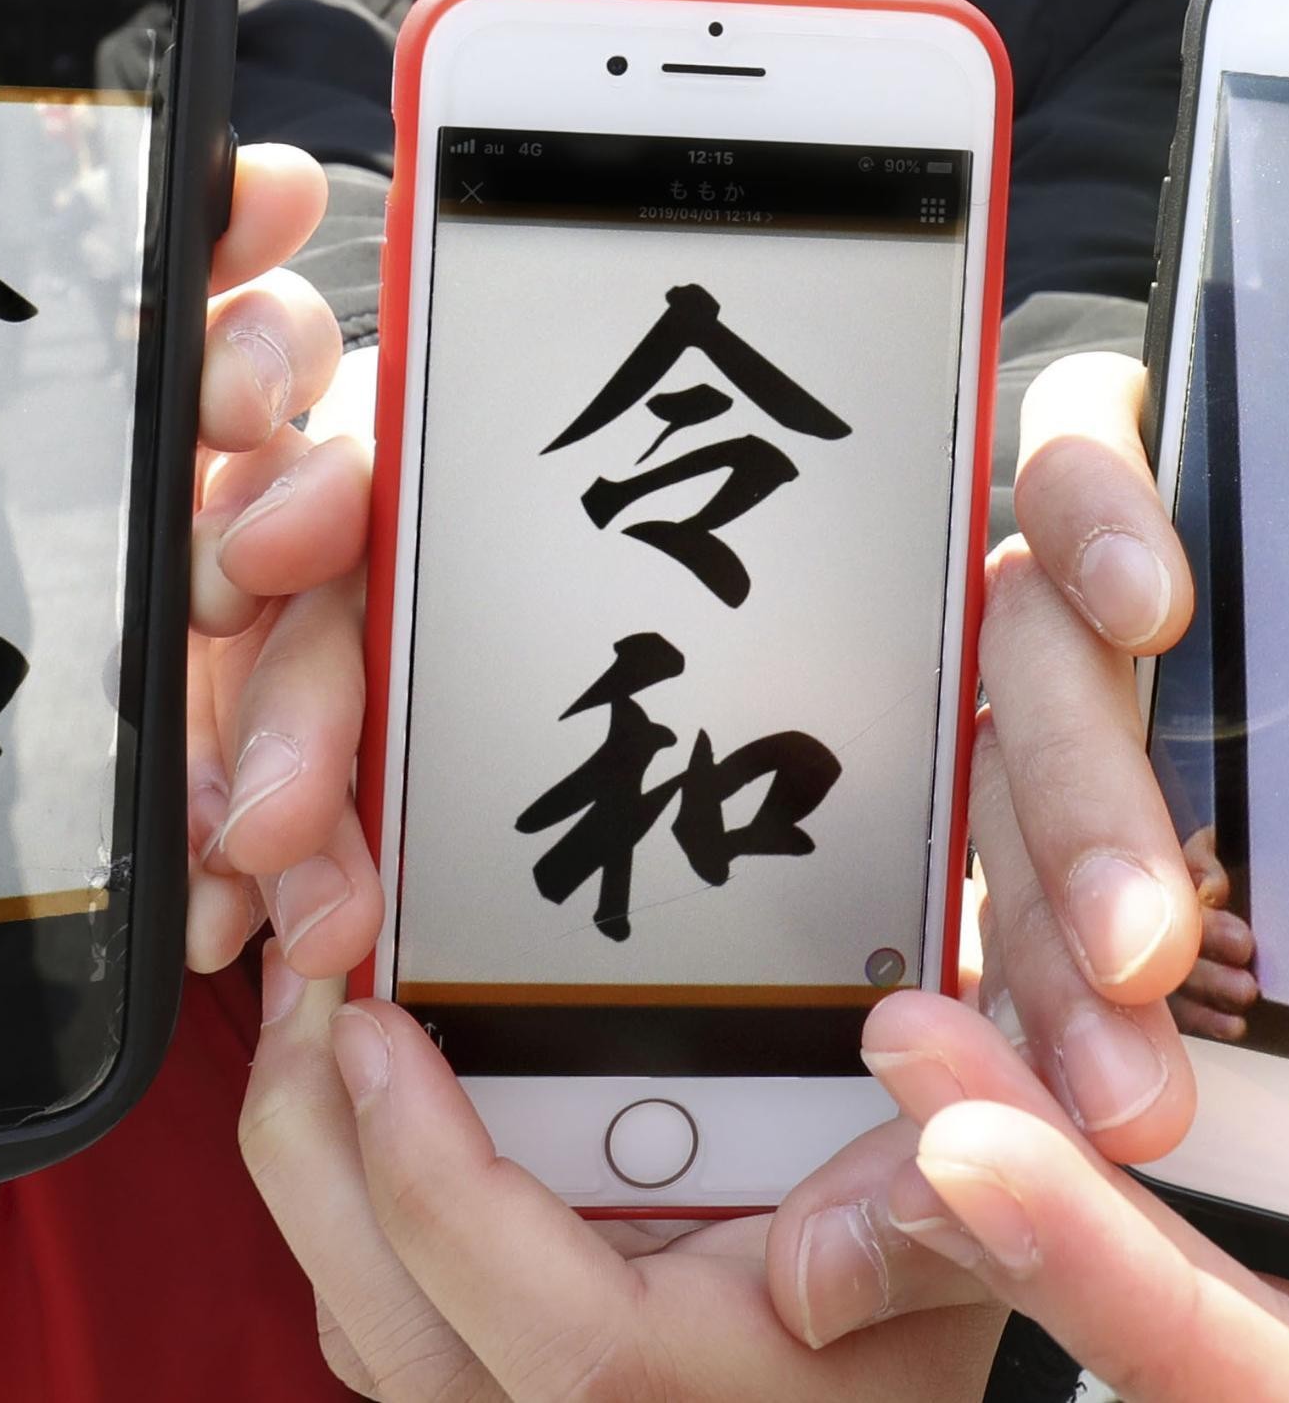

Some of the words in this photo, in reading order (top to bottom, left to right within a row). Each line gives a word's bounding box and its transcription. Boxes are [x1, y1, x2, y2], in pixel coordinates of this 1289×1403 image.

[483, 140, 506, 157] au
[518, 141, 544, 158] 4G
[687, 149, 735, 167] 12:15
[883, 157, 922, 175] 90%
[668, 179, 746, 201] ももか
[638, 205, 721, 224] 2019/04/01
[723, 207, 763, 224] 12:14
[514, 283, 853, 943] 令和
